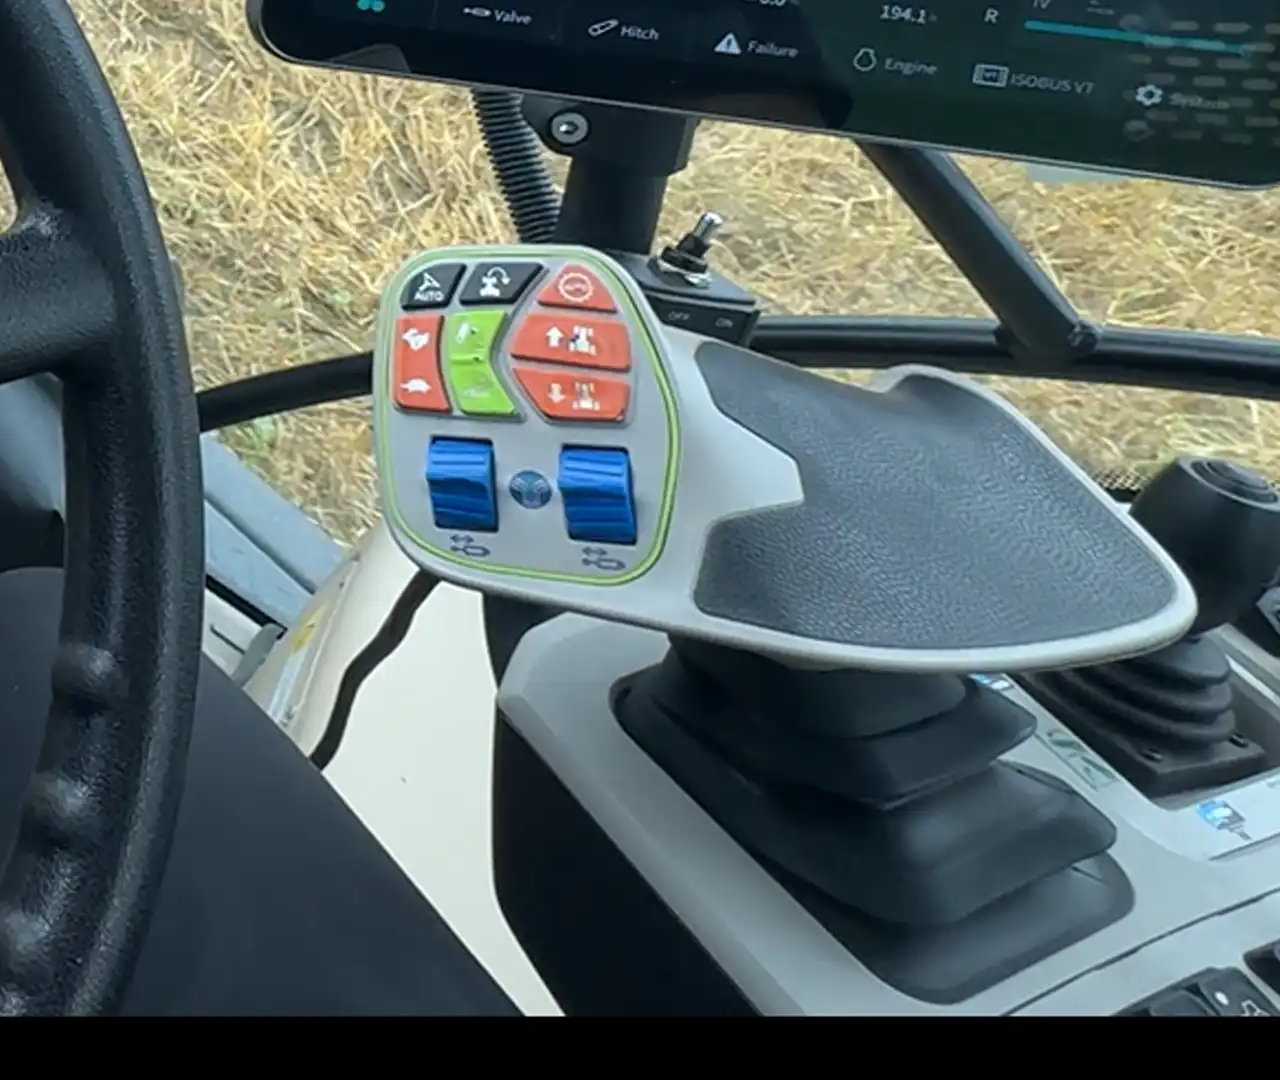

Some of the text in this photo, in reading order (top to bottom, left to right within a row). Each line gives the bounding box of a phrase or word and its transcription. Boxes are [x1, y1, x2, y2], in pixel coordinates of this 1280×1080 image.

[494, 9, 532, 25] Valve
[880, 4, 927, 24] 194.1
[984, 7, 1000, 23] R
[620, 25, 660, 41] Hitch
[747, 40, 799, 58] Failure
[884, 57, 938, 76] Engine
[1010, 73, 1073, 92] ISOBUS
[414, 290, 445, 302] AUTO
